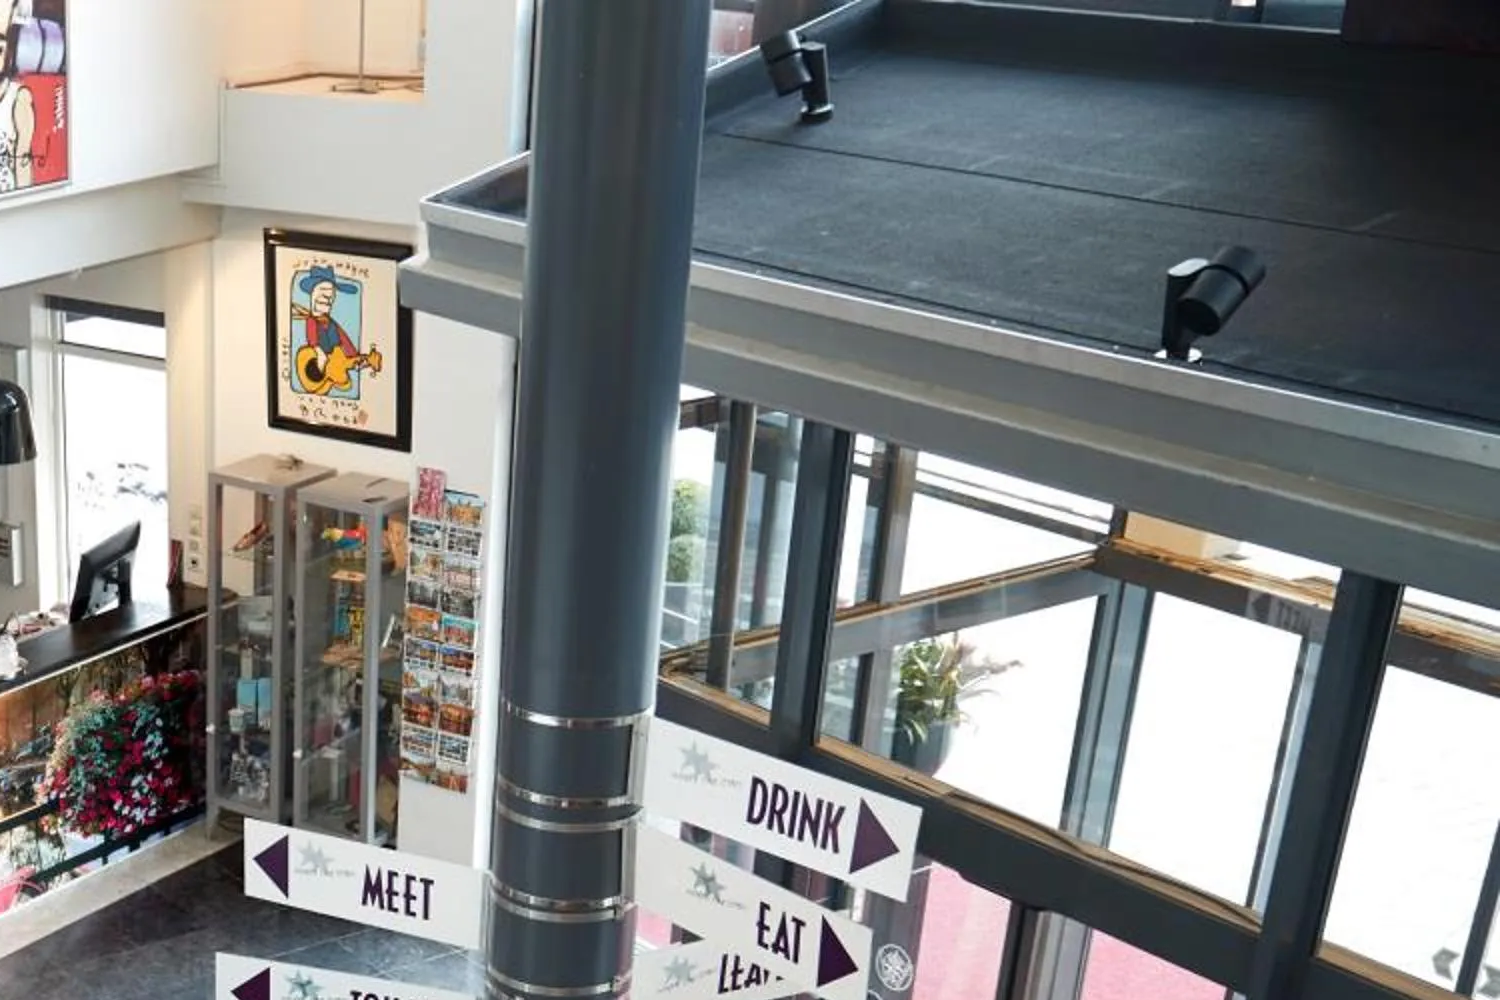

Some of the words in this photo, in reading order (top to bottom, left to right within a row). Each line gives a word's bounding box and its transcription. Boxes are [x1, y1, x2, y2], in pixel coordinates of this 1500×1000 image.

[746, 775, 846, 854] DRINK
[361, 863, 435, 920] MEET
[756, 901, 806, 964] EAT
[718, 953, 785, 994] LEA
